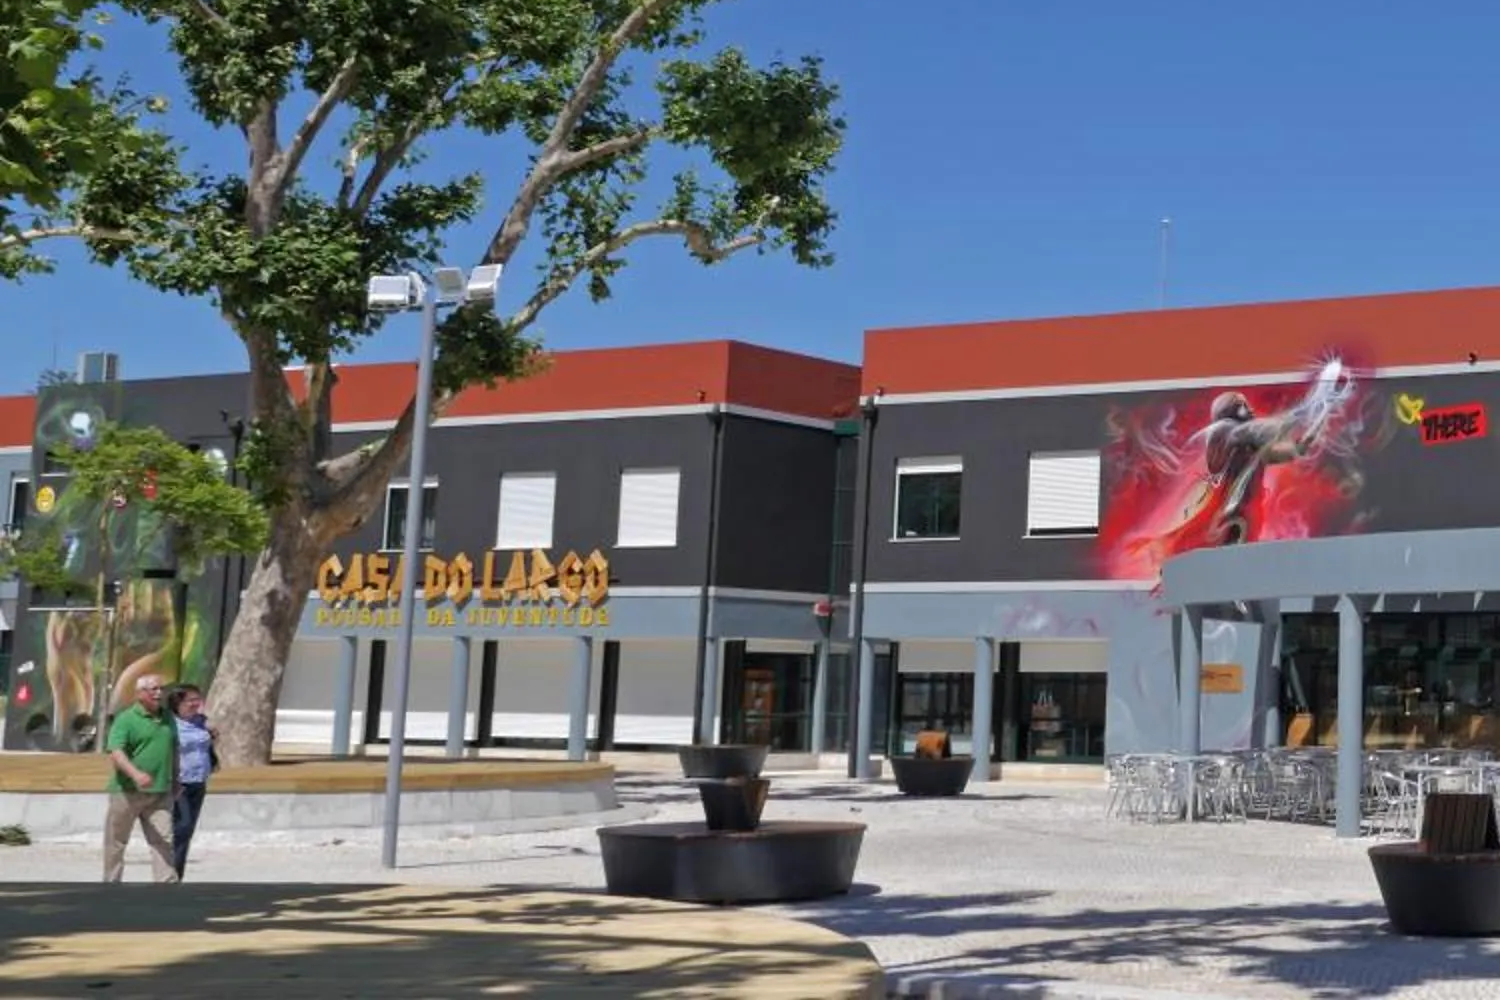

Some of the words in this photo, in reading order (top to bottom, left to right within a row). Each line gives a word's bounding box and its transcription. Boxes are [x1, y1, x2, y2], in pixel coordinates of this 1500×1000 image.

[424, 552, 473, 605] DO
[480, 547, 609, 606] LARGO
[316, 607, 402, 628] POUSAD
[427, 607, 456, 627] DA
[467, 606, 609, 628] JUVENTUDE
